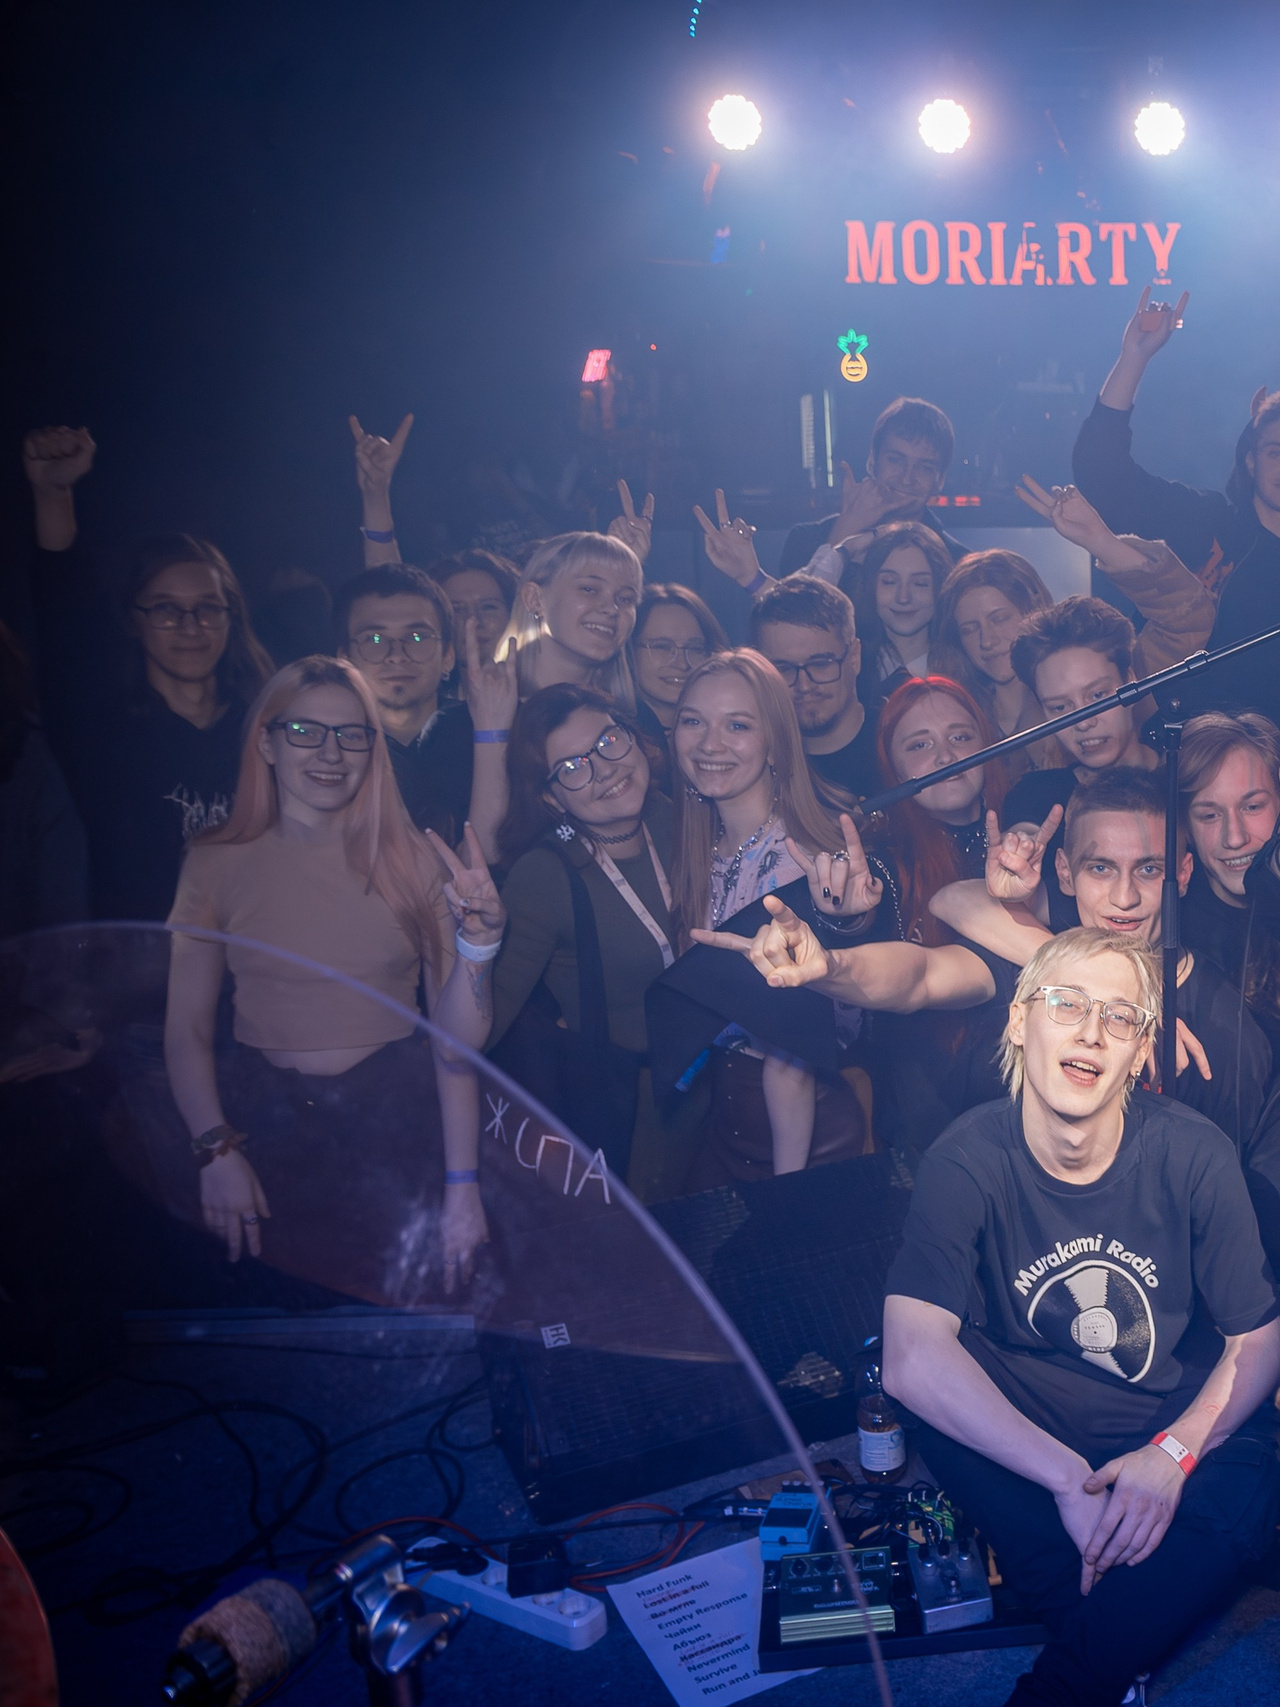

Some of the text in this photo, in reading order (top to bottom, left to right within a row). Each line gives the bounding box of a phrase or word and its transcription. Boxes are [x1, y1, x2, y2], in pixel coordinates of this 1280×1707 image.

[844, 219, 1182, 286] MORIARTY
[1013, 1233, 1160, 1297] Murakami Radio
[636, 1584, 665, 1599] Hard
[665, 1574, 692, 1589] Funk
[657, 1592, 748, 1630] Empty Response
[687, 1643, 751, 1673] Nevermind
[694, 1663, 738, 1684] Survive
[702, 1682, 727, 1696] Run
[728, 1672, 751, 1686] and
